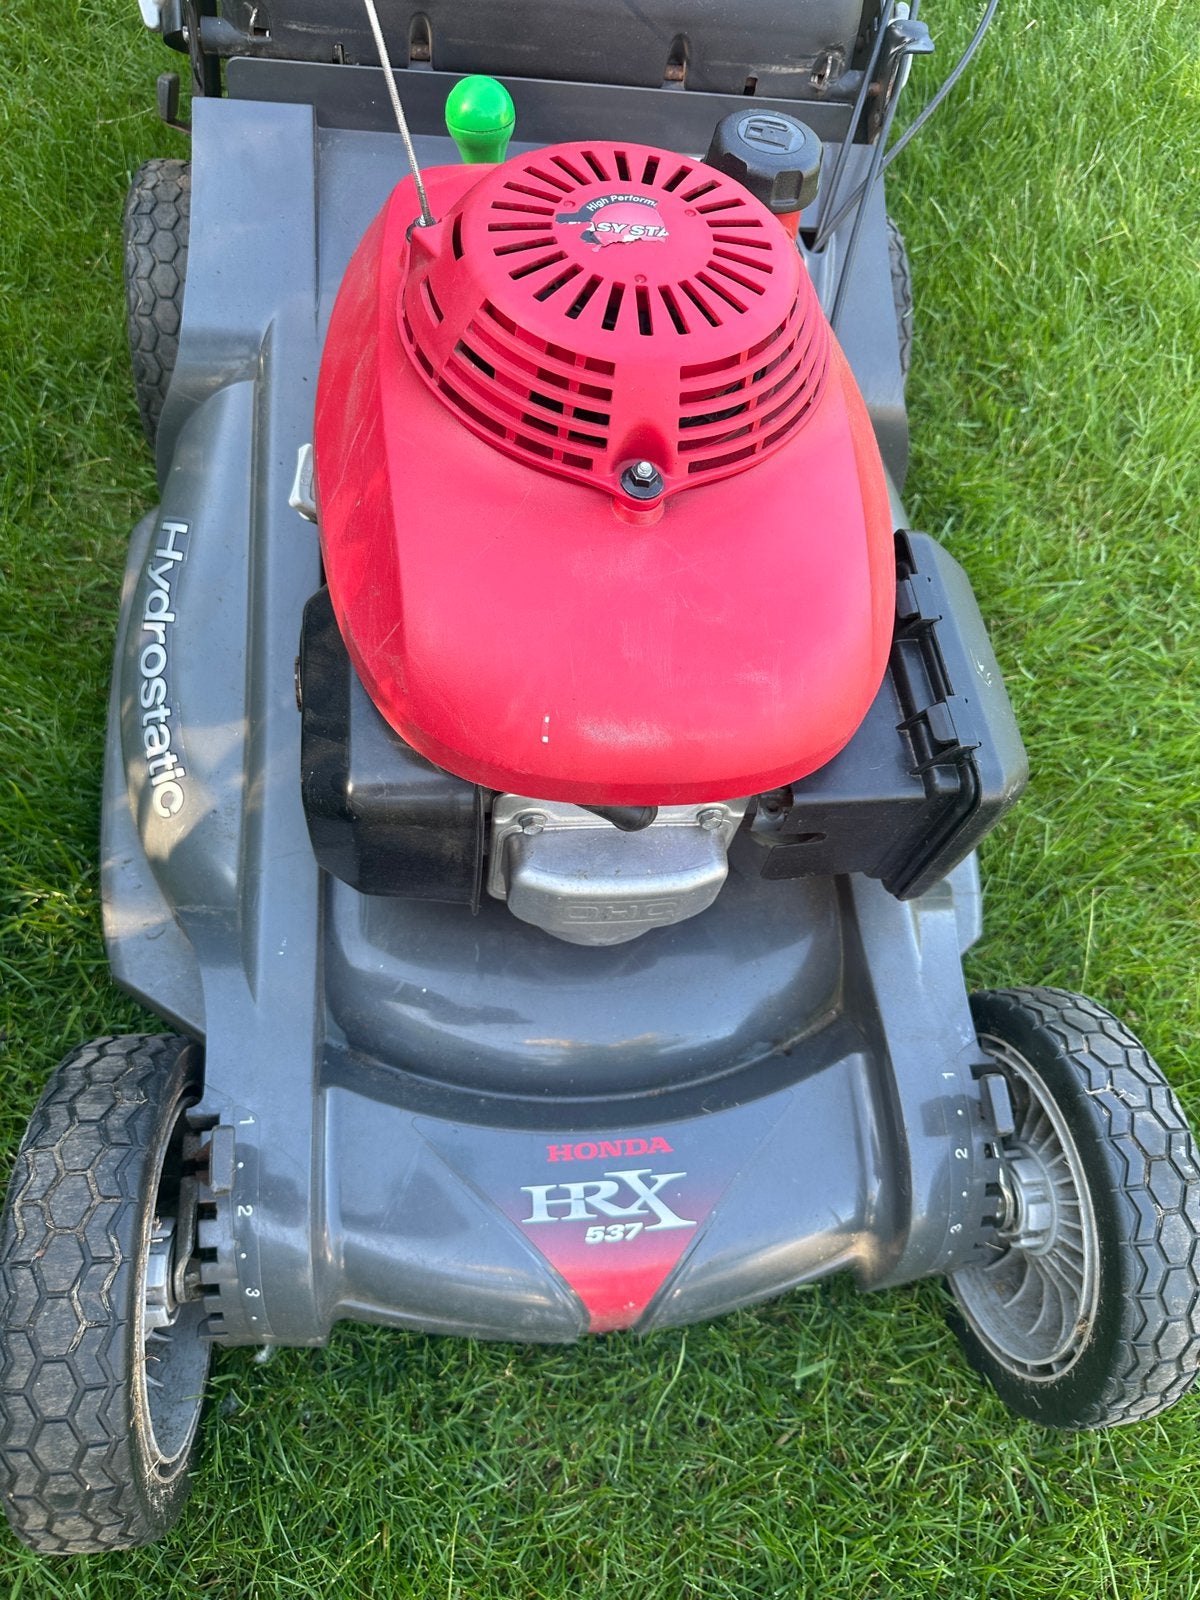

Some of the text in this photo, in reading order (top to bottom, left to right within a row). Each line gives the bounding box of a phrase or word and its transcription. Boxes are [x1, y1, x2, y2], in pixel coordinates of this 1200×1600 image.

[586, 196, 609, 212] High
[139, 521, 190, 819] Hydrostatic
[942, 1071, 955, 1080] 1
[239, 1115, 255, 1125] 1
[546, 1136, 675, 1163] HONDA
[955, 1147, 968, 1159] 2
[520, 1168, 698, 1232] HRX
[238, 1204, 254, 1217] 2
[584, 1221, 644, 1245] 537
[950, 1222, 963, 1235] 3
[245, 1286, 261, 1298] 3
